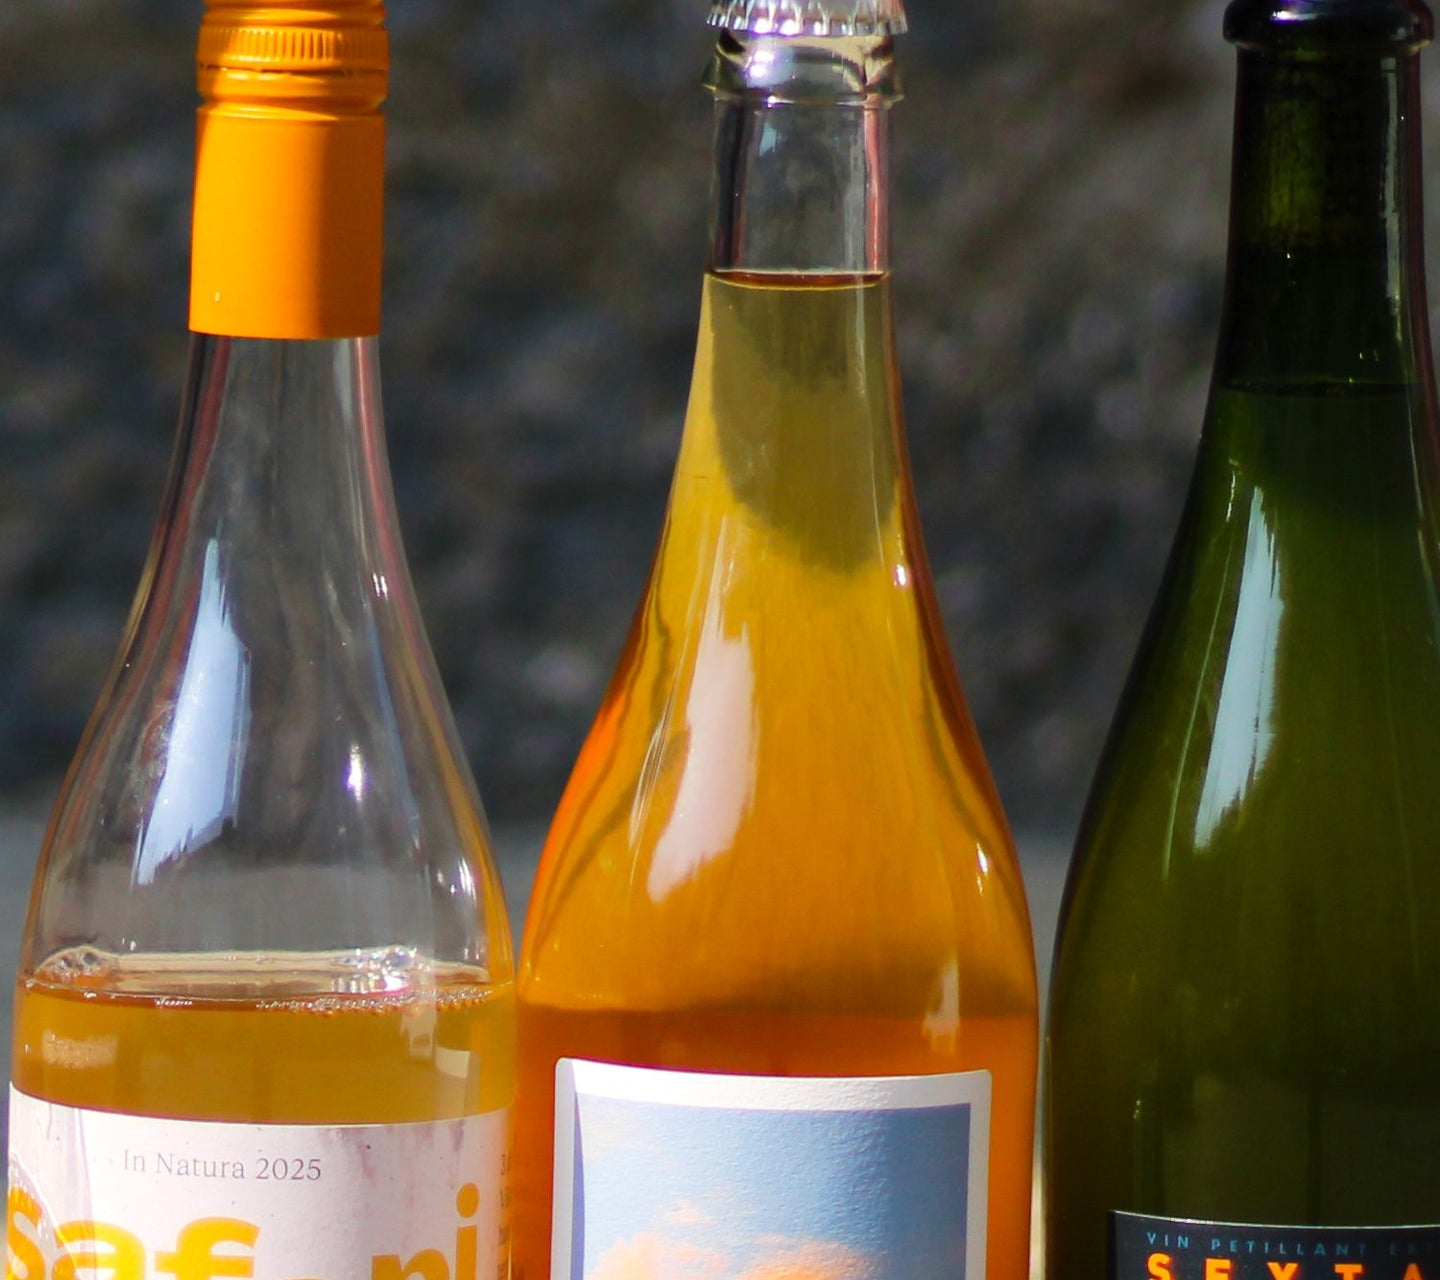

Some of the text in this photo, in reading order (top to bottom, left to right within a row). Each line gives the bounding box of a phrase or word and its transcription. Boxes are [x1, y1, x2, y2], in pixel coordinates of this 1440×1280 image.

[123, 1149, 322, 1181] In Natura 2025
[1146, 1232, 1189, 1249] VIN
